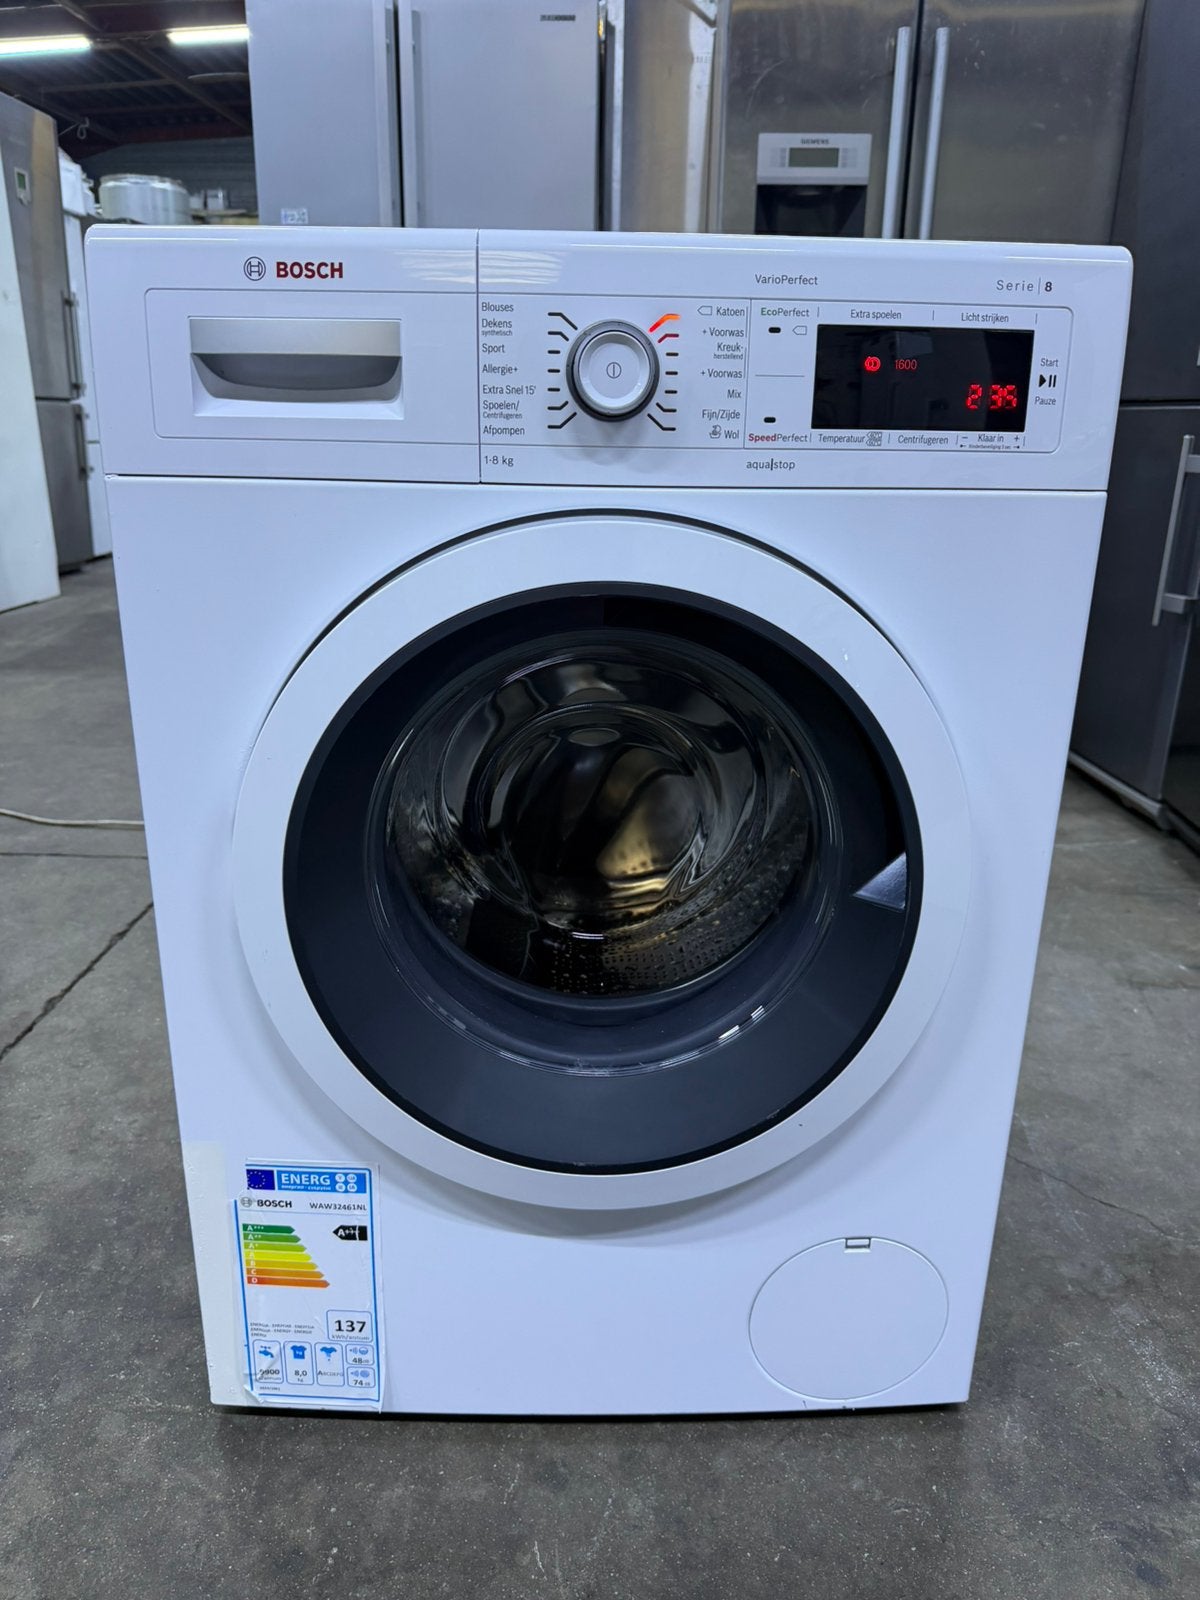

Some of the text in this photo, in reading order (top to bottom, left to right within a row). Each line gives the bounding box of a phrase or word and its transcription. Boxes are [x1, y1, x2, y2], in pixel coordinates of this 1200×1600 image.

[276, 261, 343, 279] BOSCH
[754, 274, 818, 285] VarioPerfect
[996, 280, 1053, 292] Serie 8
[481, 302, 514, 312] Blouses
[716, 306, 745, 317] Katoen
[760, 307, 810, 317] EcoPerfect
[850, 309, 902, 320] Extra spoelen
[961, 313, 1009, 324] Licht strijken
[481, 318, 513, 328] Dekens
[481, 329, 513, 337] synthetisch
[709, 327, 744, 337] Voorwas
[481, 343, 506, 355] Sport
[717, 342, 744, 352] Kreuk-
[895, 359, 917, 370] 1600
[1040, 358, 1059, 367] Start
[482, 364, 518, 376] Allergie+
[707, 368, 743, 379] Voorwas
[482, 385, 504, 395] Extra
[505, 385, 524, 395] Snel
[727, 389, 742, 399] Mix
[482, 400, 520, 412] Spoelen/
[1034, 396, 1057, 406] Pauze
[482, 411, 523, 420] Centrifugeren
[701, 409, 741, 421] Fijn/Zijde
[482, 425, 525, 437] Afpompen
[723, 430, 740, 440] Wol
[748, 433, 808, 443] SpeedPerfect
[818, 433, 866, 444] Temperatuur
[897, 434, 949, 446] Centrifugeren
[977, 433, 996, 442] Klaar
[997, 433, 1004, 442] in
[501, 455, 514, 467] kg
[281, 1173, 331, 1185] ENERG
[257, 1199, 367, 1211] BOSCH WAW32461NL
[335, 1319, 367, 1333] 137
[294, 1369, 308, 1377] 8,0
[353, 1379, 363, 1387] 74
